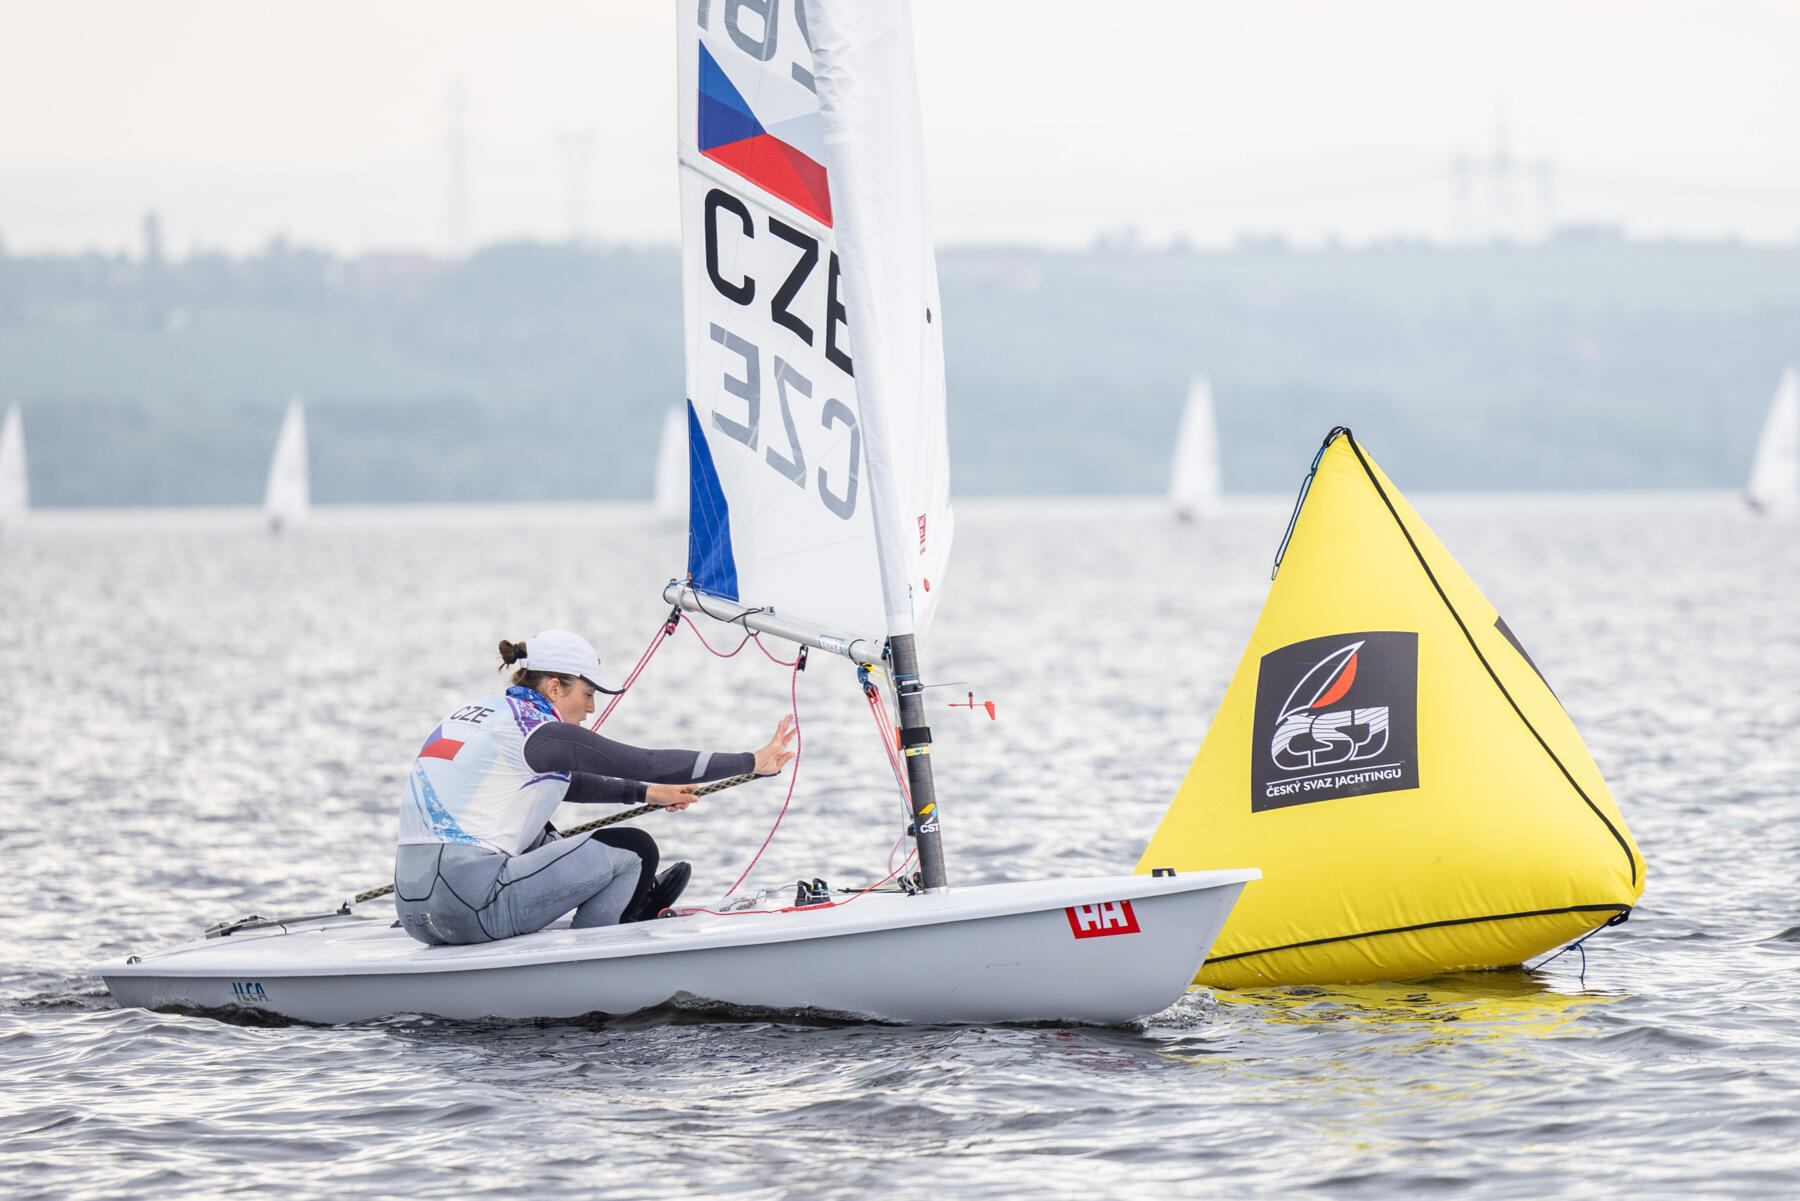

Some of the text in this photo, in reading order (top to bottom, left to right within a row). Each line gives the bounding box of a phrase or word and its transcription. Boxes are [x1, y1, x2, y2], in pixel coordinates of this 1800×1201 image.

[450, 705, 495, 724] CZE
[1265, 768, 1402, 798] ČESKÝ SVAZ JACHTINGU
[920, 822, 939, 834] CST
[1073, 901, 1129, 931] HH
